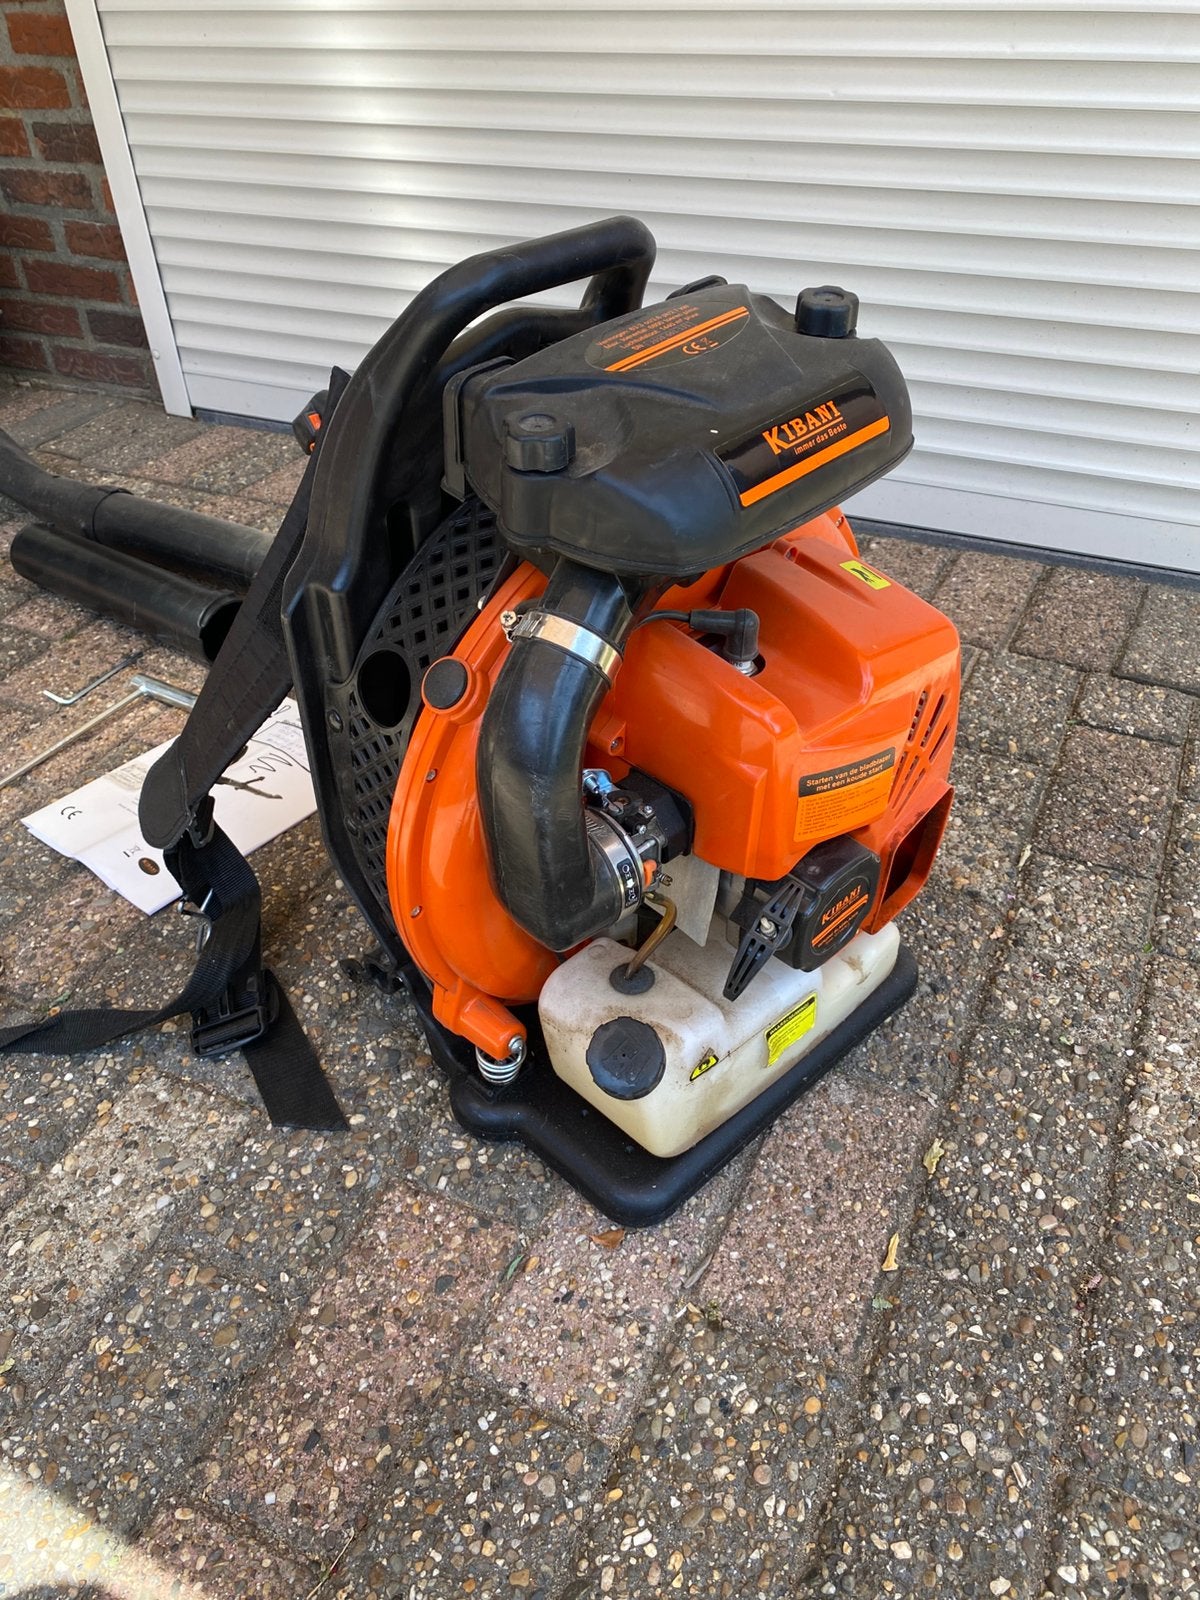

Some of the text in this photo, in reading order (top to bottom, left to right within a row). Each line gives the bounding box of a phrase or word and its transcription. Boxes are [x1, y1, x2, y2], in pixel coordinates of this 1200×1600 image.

[762, 400, 841, 455] KIBANI
[816, 433, 829, 443] das
[828, 422, 847, 437] Beste
[806, 753, 892, 787] Starten van de bladblazer
[816, 764, 883, 792] met een koude start
